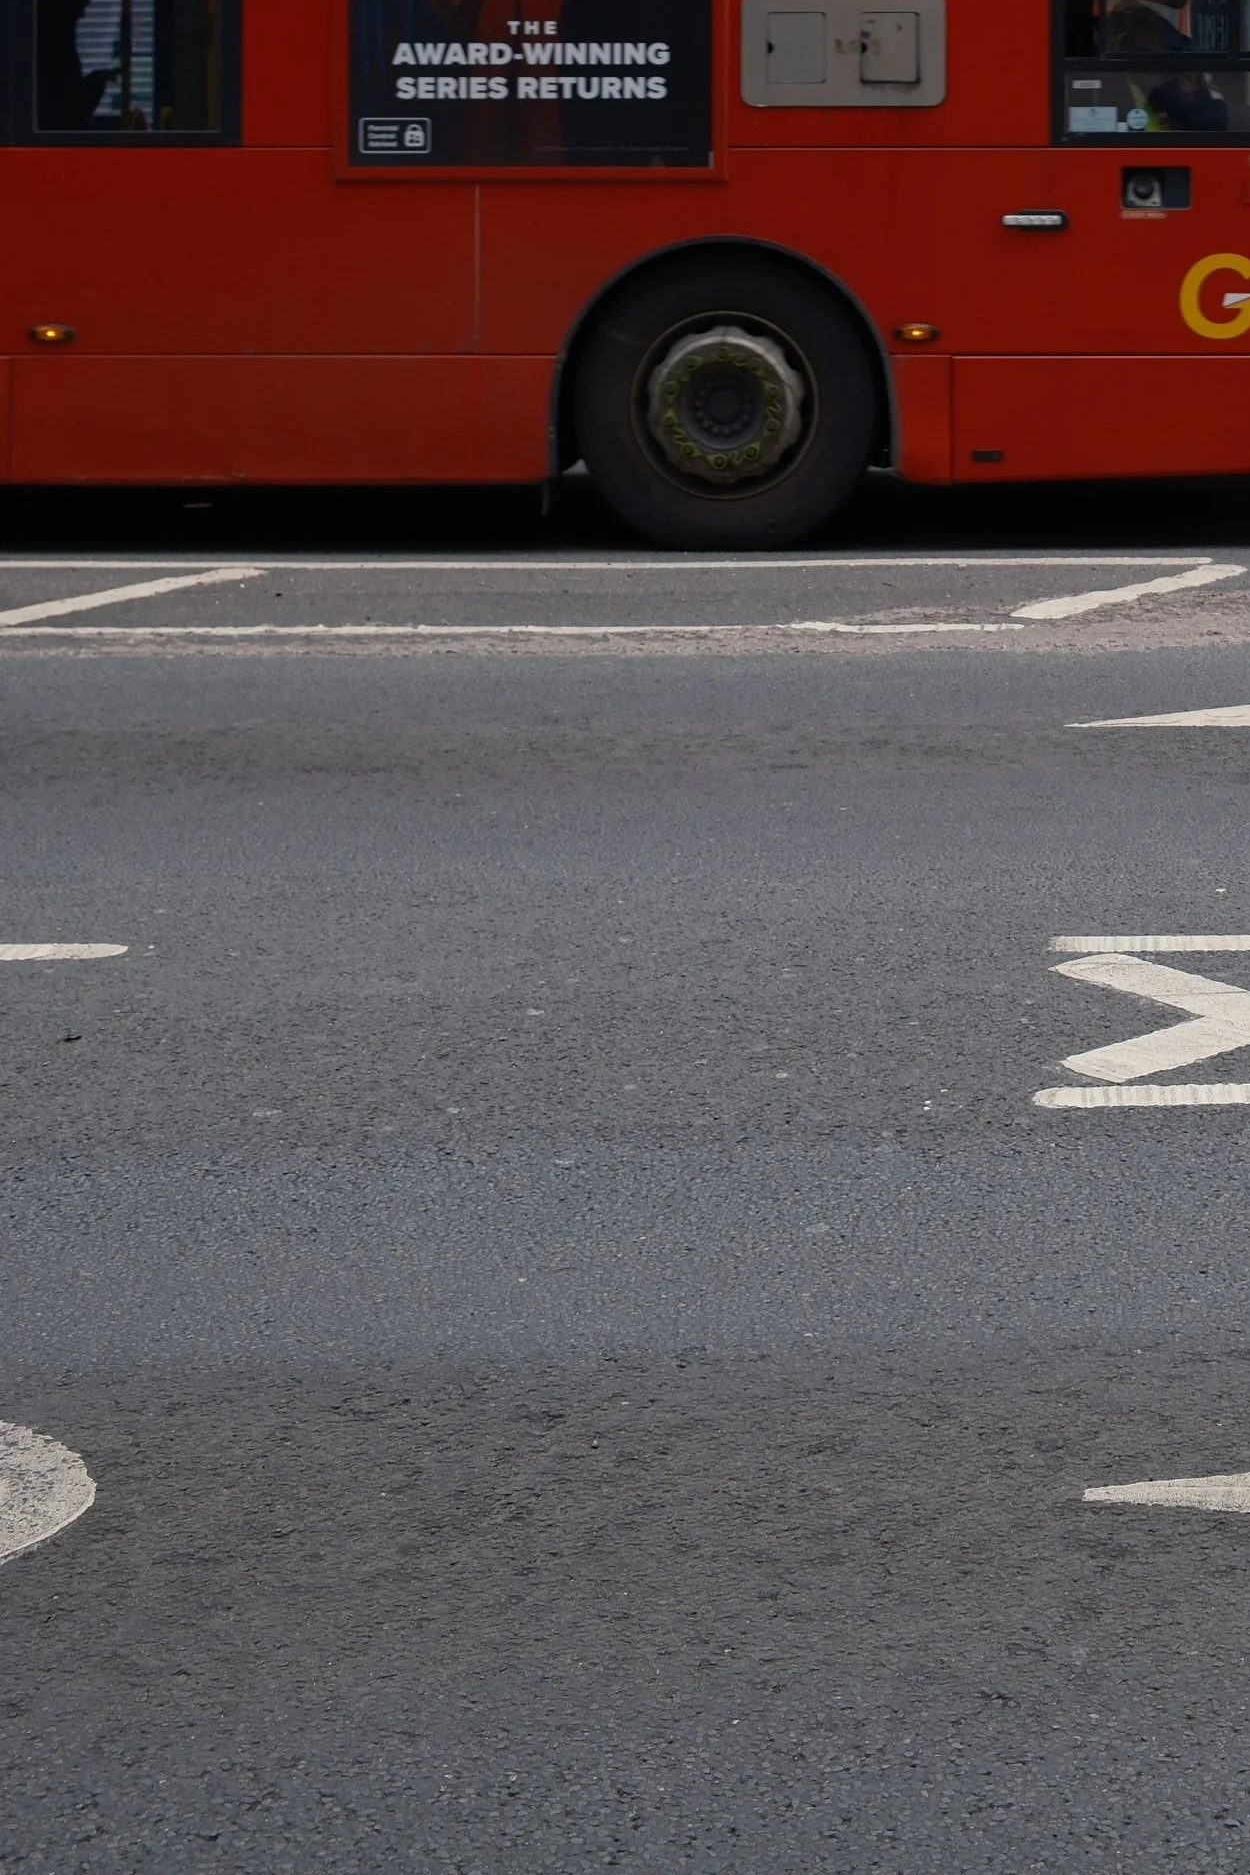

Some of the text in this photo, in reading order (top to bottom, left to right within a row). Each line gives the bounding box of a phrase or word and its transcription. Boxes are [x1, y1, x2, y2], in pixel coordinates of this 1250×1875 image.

[507, 20, 558, 35] THE
[392, 42, 672, 66] AWARD-WINNING
[396, 76, 668, 100] SERIES RETURNS
